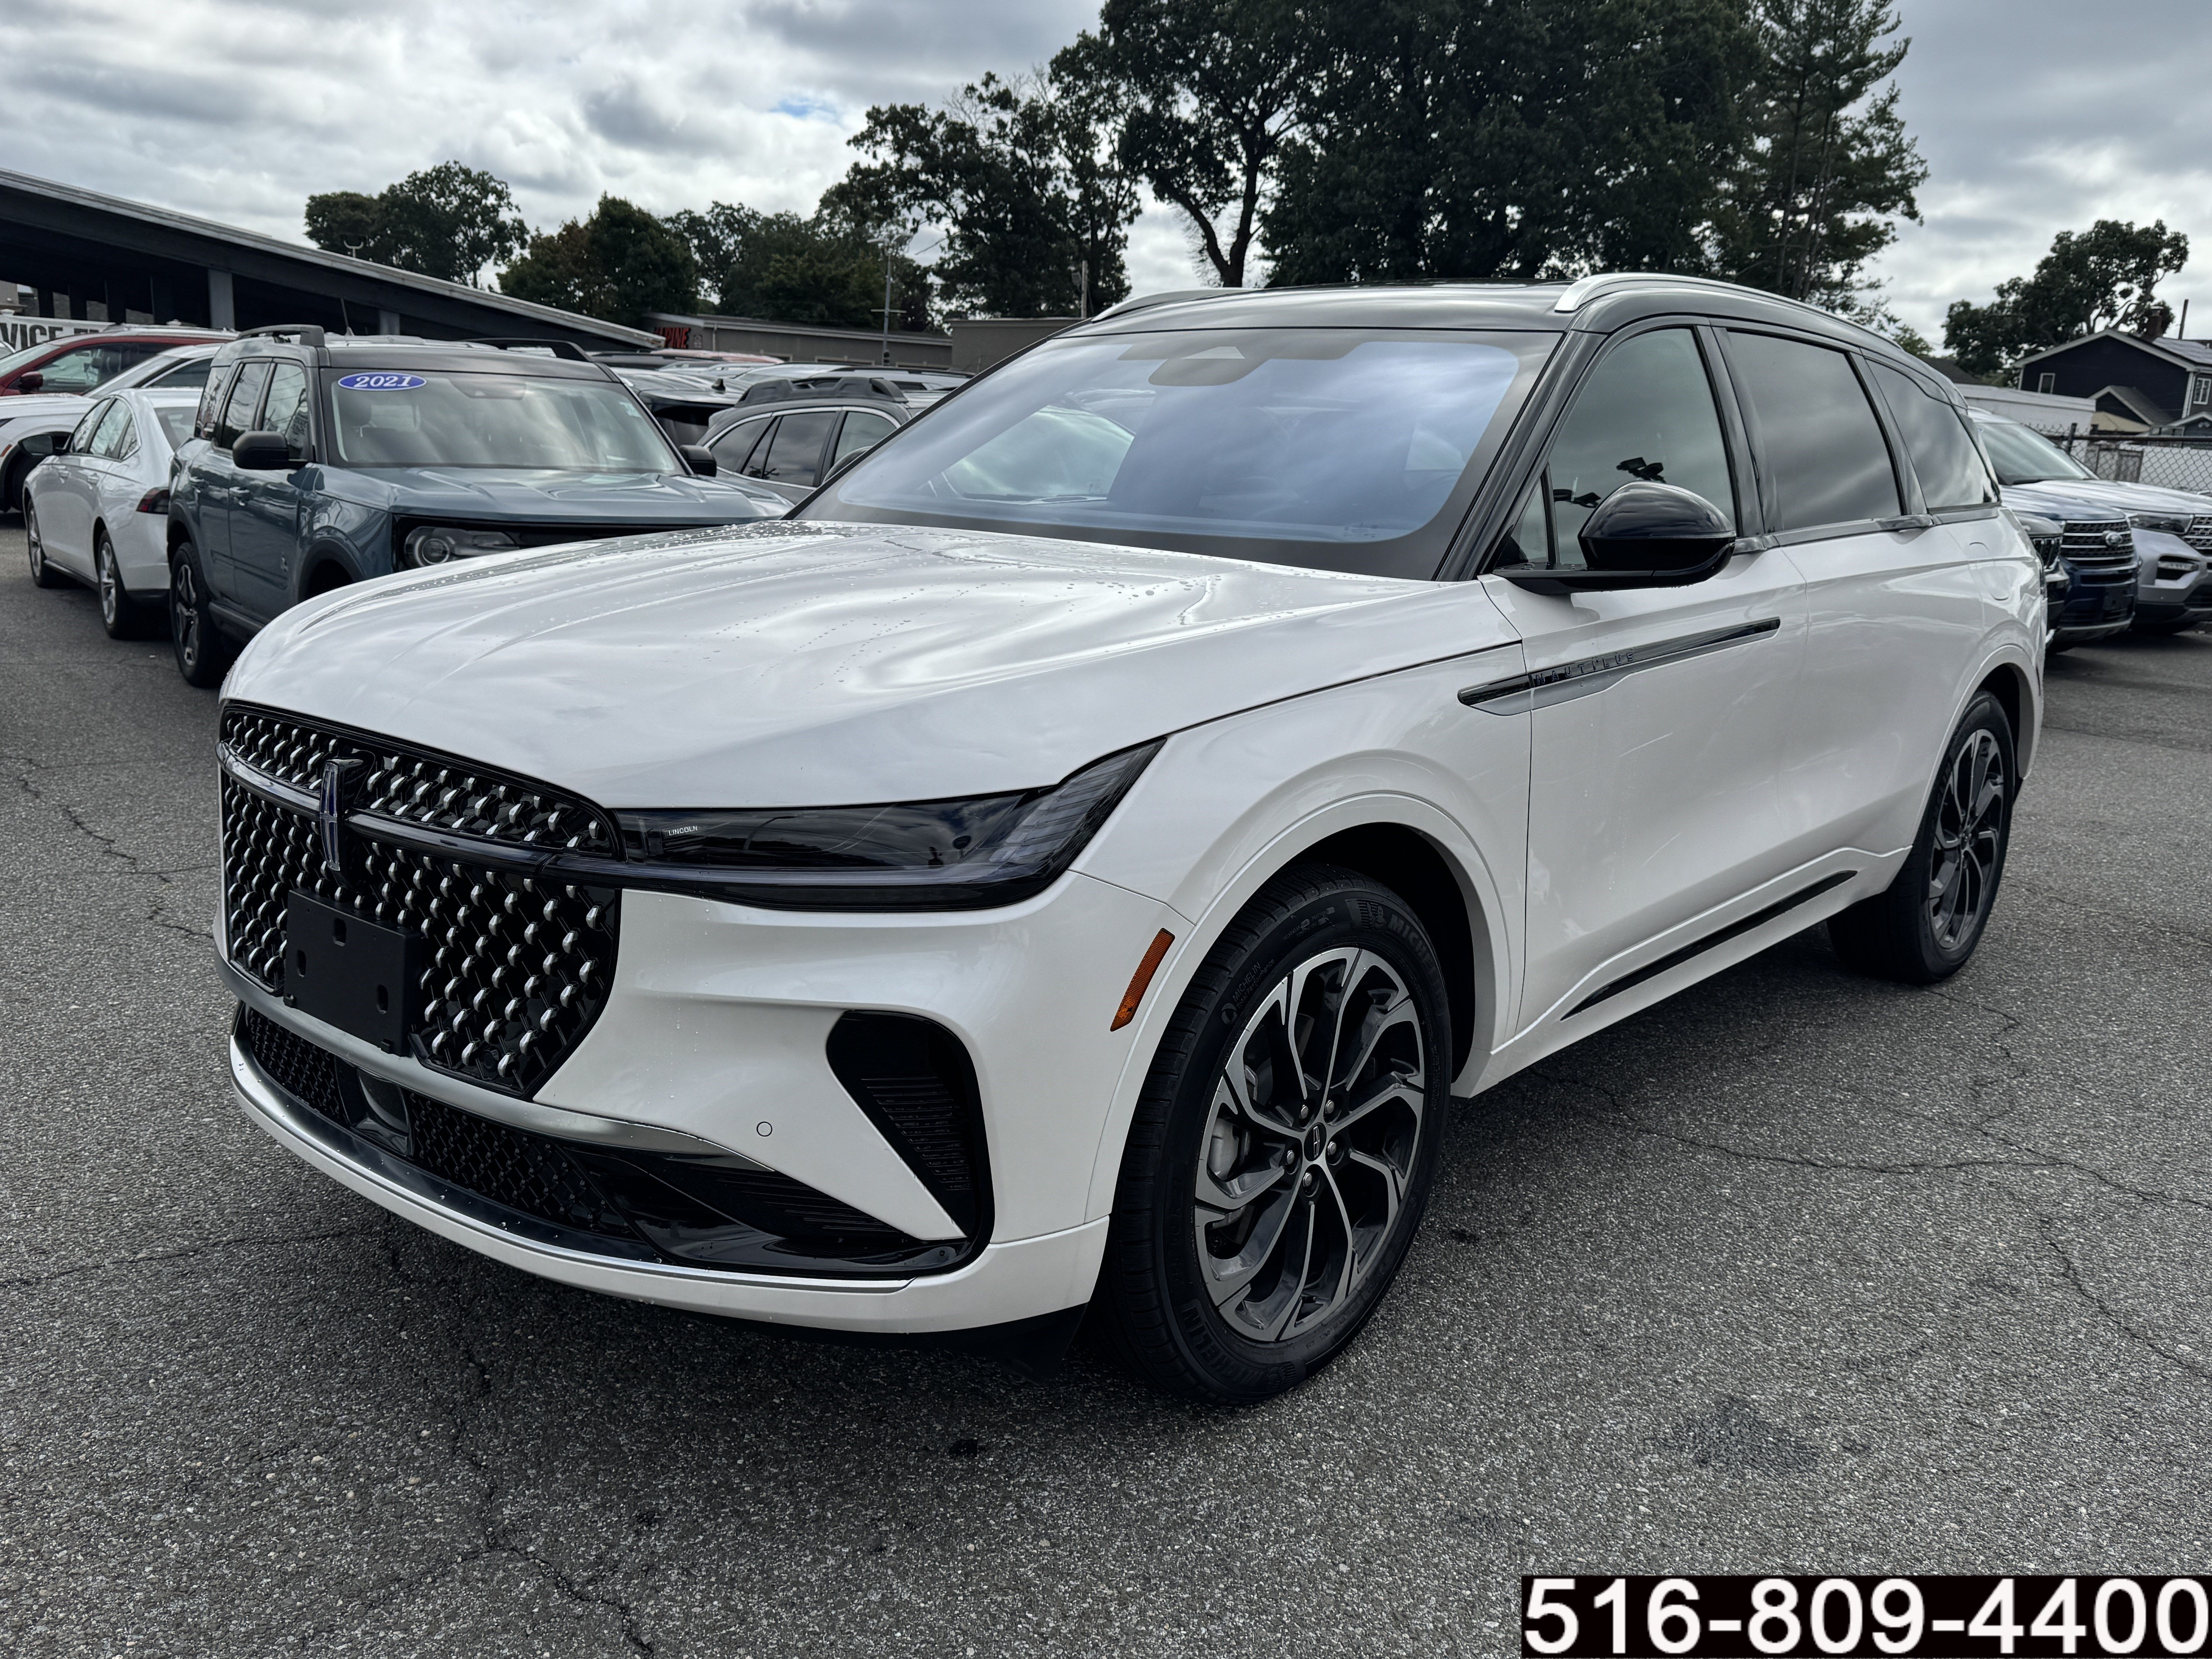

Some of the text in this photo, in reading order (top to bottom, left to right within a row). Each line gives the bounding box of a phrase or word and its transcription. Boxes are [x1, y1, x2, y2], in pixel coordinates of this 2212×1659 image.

[353, 376, 412, 387] 2021
[668, 825, 698, 836] LINCOLN
[1233, 962, 1261, 1002] MICHELIN
